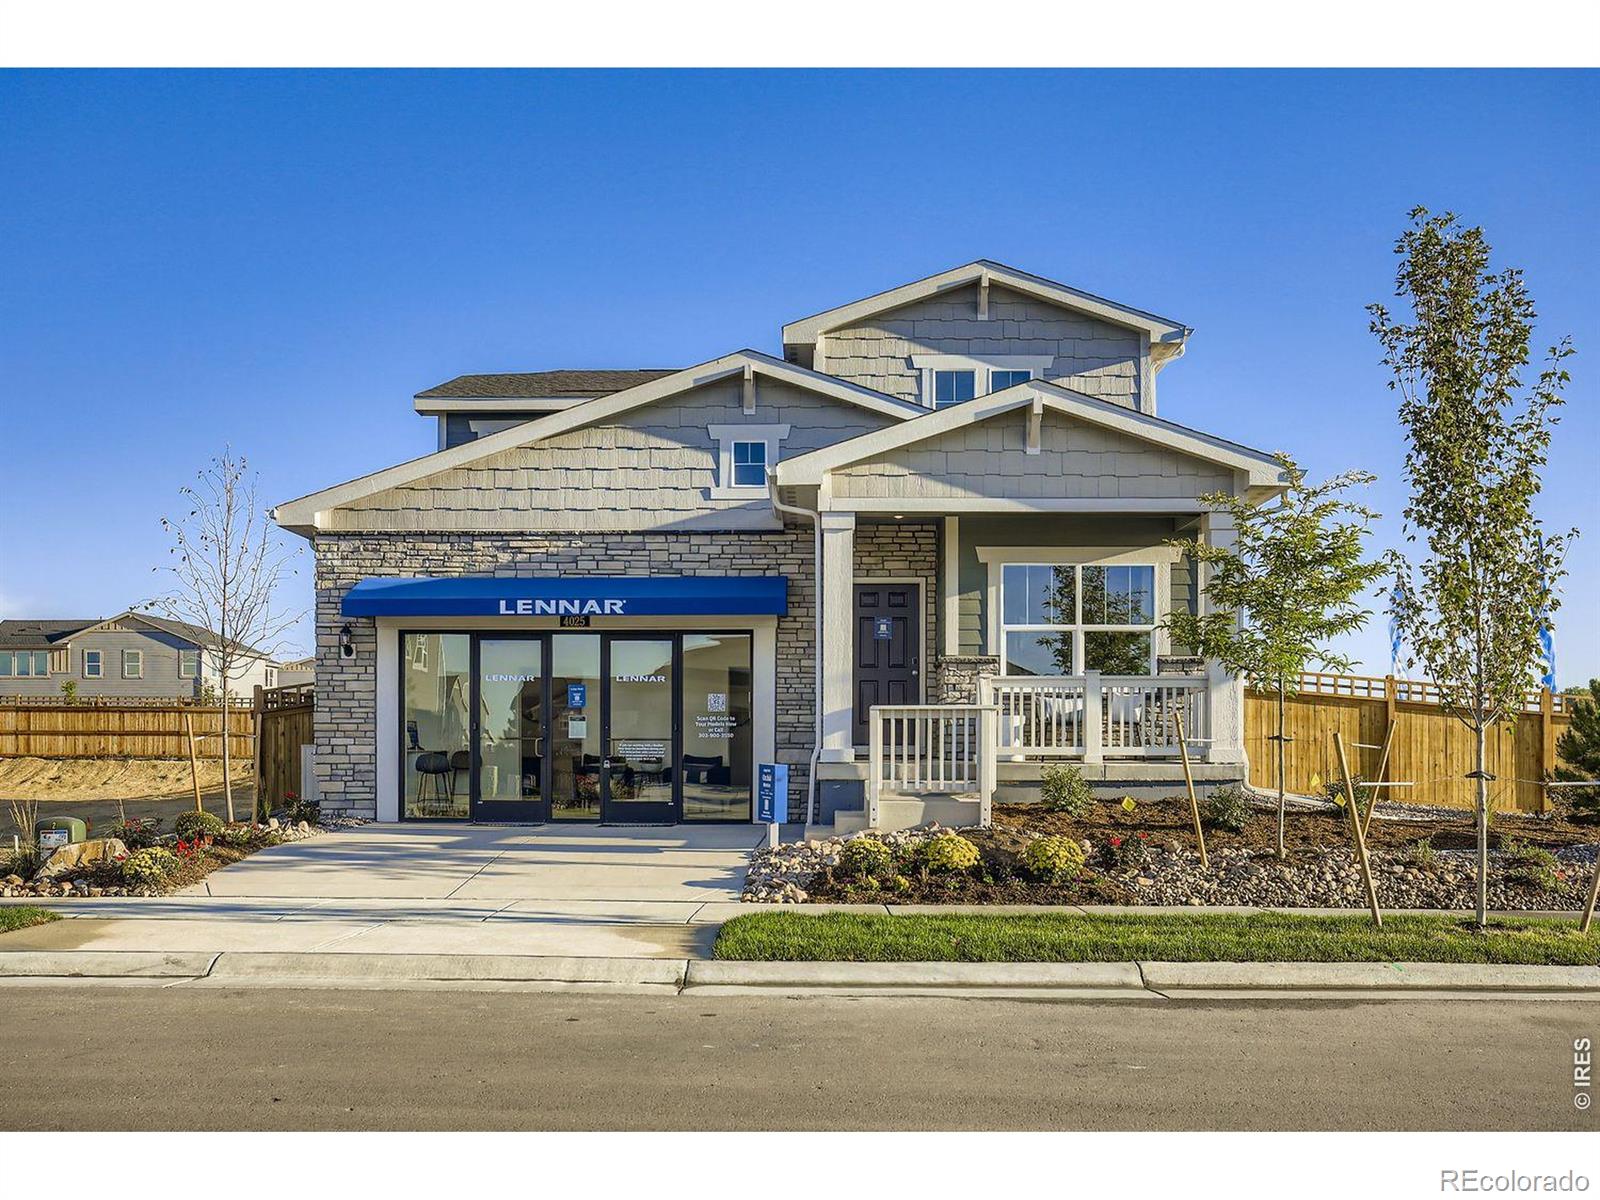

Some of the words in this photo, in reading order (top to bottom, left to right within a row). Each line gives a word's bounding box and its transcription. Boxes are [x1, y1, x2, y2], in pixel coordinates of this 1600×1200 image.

[500, 599, 626, 614] LENNAR
[562, 616, 586, 626] 4025
[485, 674, 535, 682] LENNAR
[616, 674, 666, 682] LENNAR
